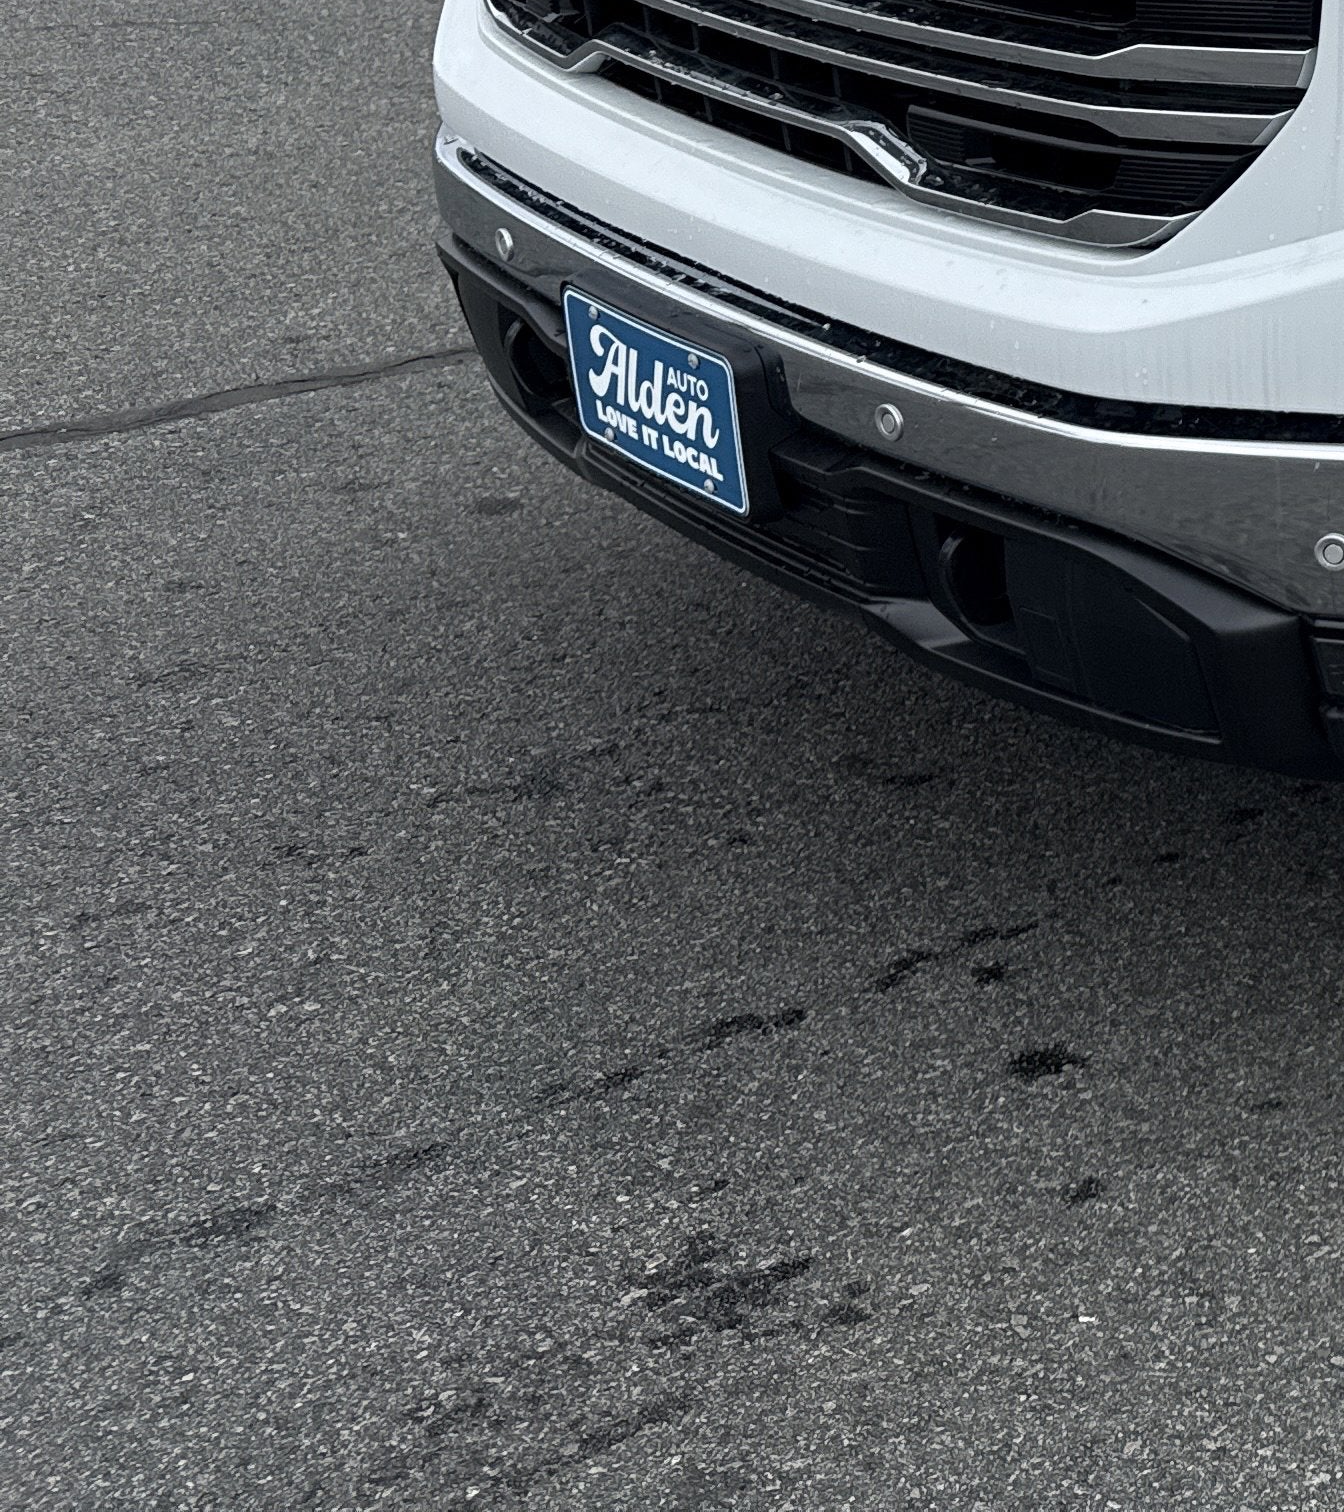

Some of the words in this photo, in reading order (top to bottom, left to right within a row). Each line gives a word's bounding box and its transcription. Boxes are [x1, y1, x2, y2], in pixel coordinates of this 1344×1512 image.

[589, 324, 720, 449] Alden
[667, 367, 709, 401] AUTO
[595, 399, 638, 439] LOVE
[642, 425, 660, 450] IT
[663, 434, 724, 481] LOCAL
